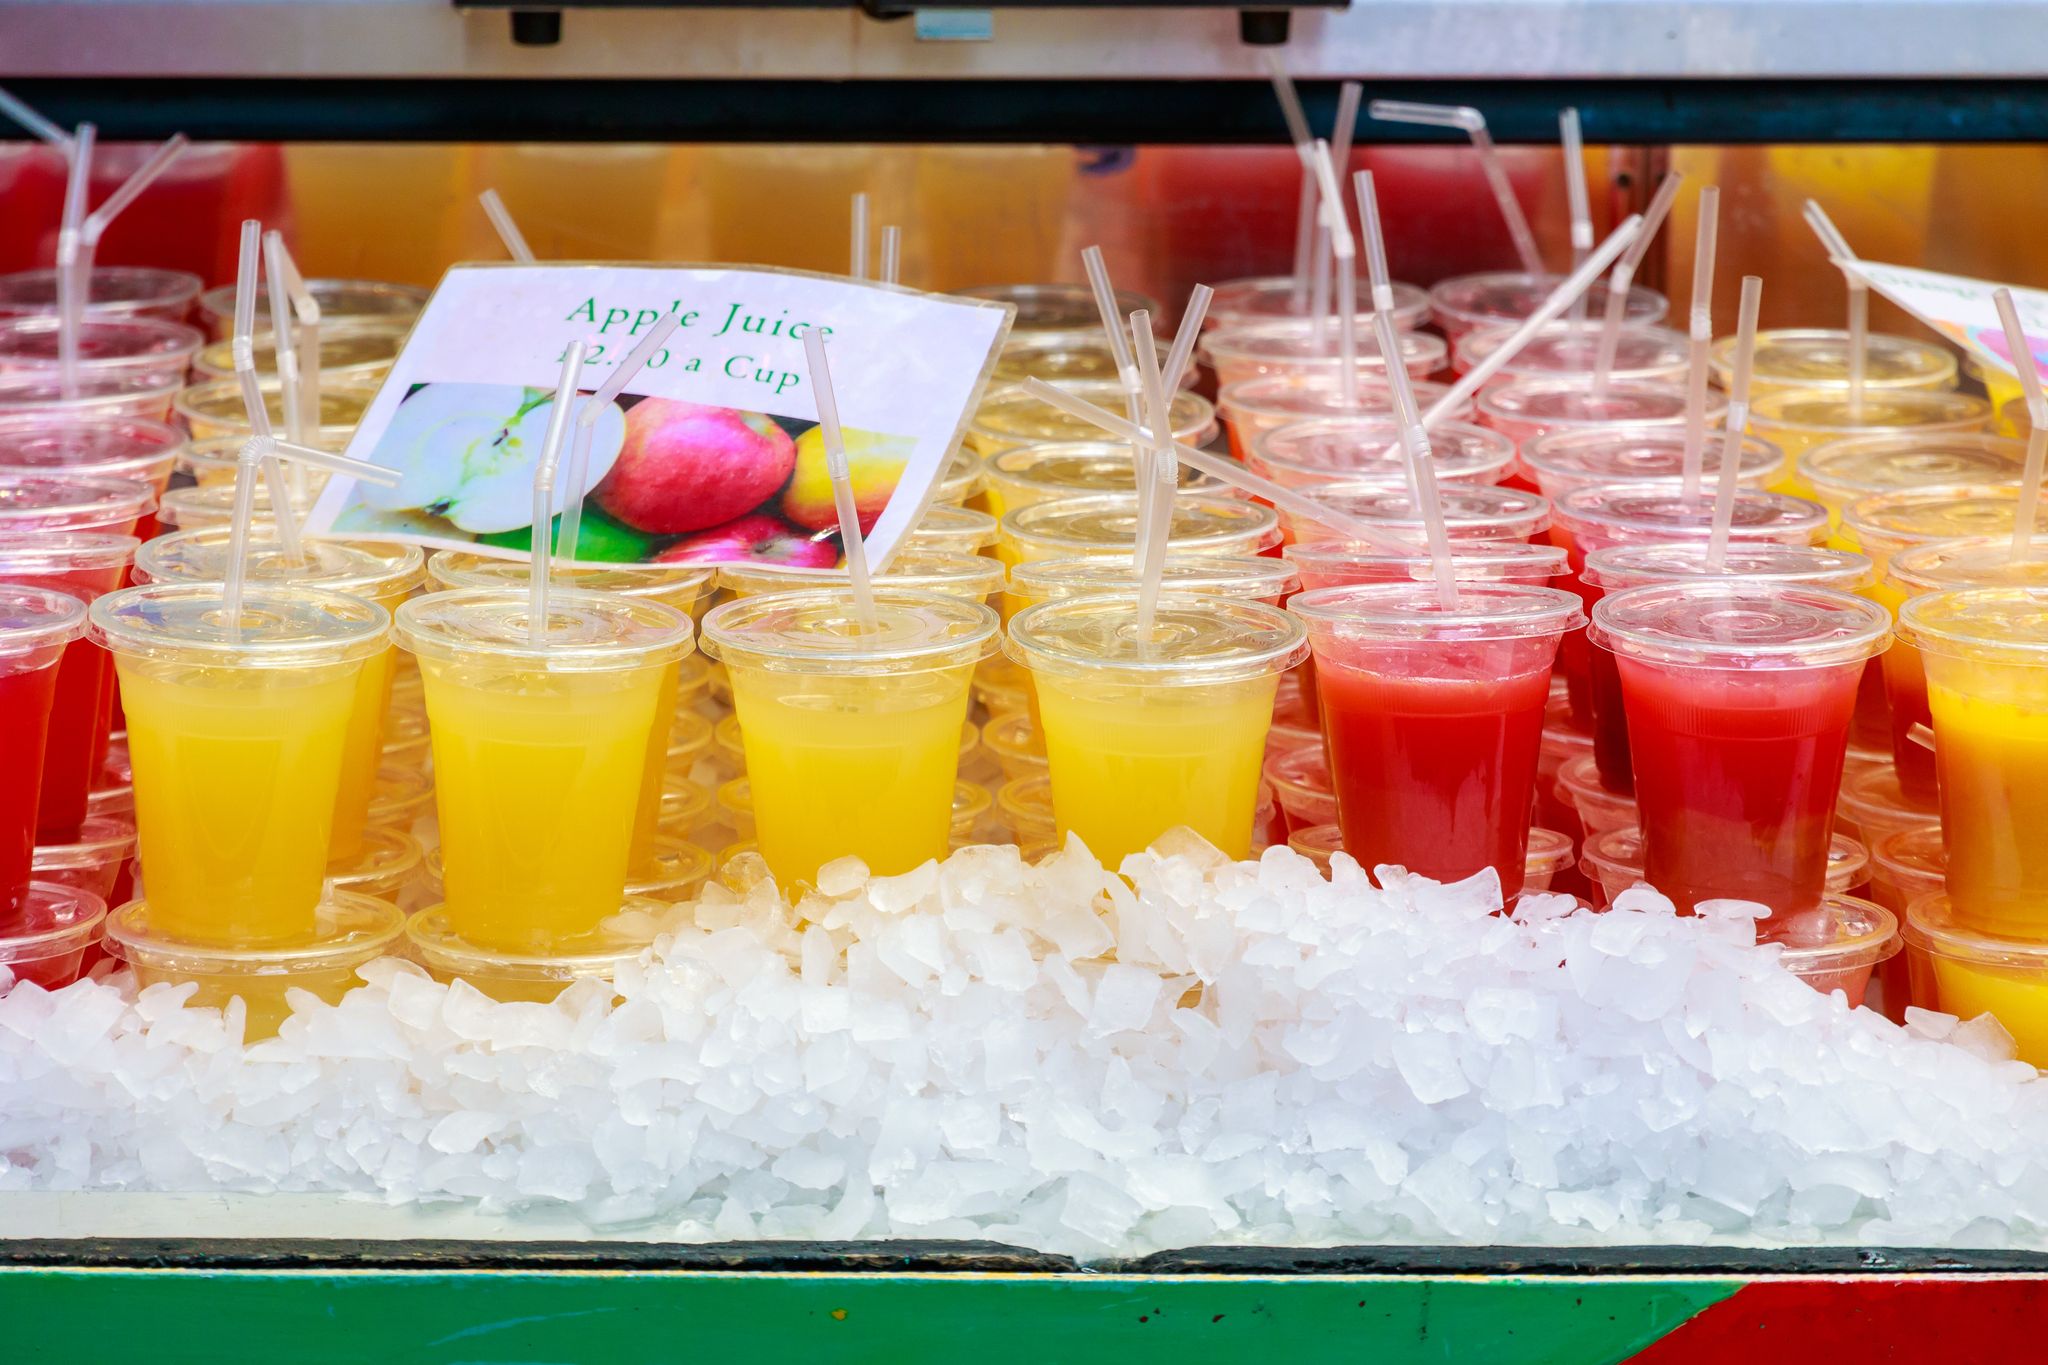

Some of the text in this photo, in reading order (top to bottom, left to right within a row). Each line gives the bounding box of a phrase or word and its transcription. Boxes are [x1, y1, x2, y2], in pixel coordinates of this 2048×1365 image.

[711, 302, 834, 344] Juice
[556, 344, 801, 395] 2.0 a Cup
